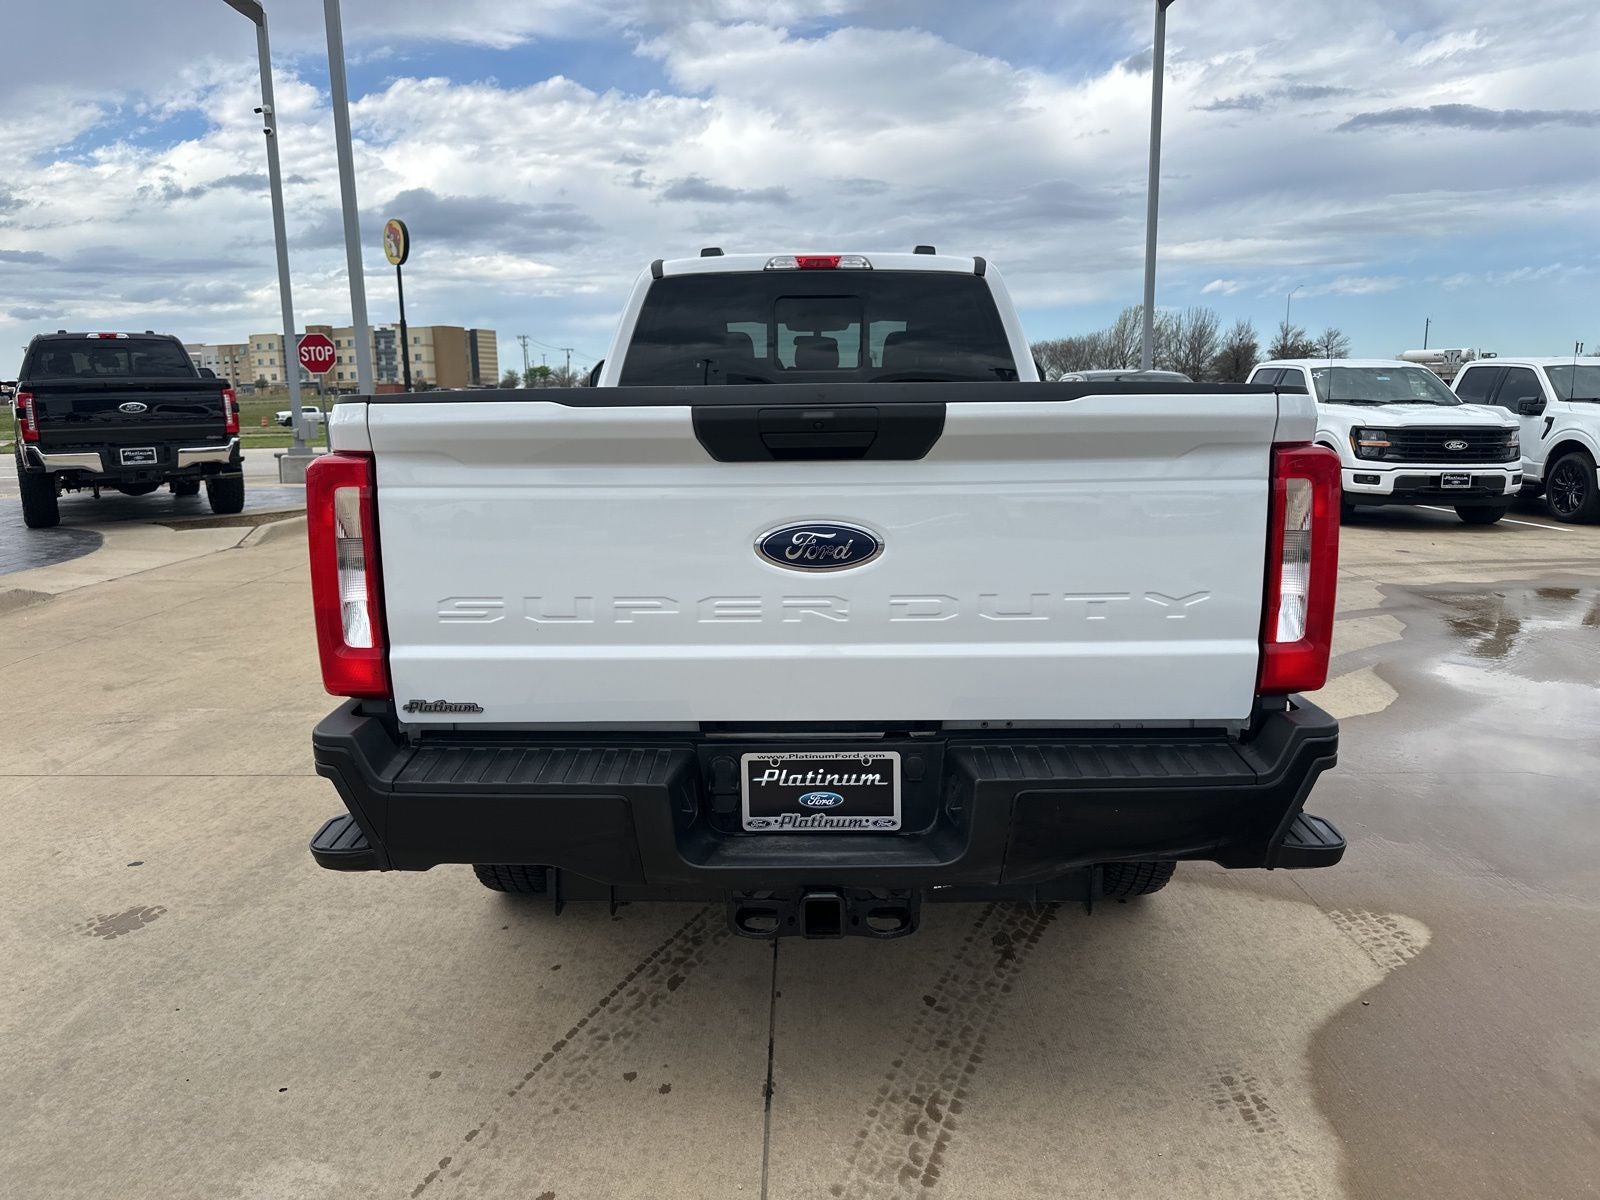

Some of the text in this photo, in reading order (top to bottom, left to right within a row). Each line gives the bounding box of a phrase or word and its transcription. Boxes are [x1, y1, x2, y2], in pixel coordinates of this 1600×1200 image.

[300, 346, 333, 361] STOP
[785, 531, 854, 560] Ford
[437, 590, 1211, 623] SUPER DUTY
[402, 699, 484, 714] Platinum
[756, 752, 886, 760] www.PlatinumFord.com
[752, 768, 888, 787] Platinum
[807, 794, 835, 806] Ford
[779, 813, 869, 829] Platinum
